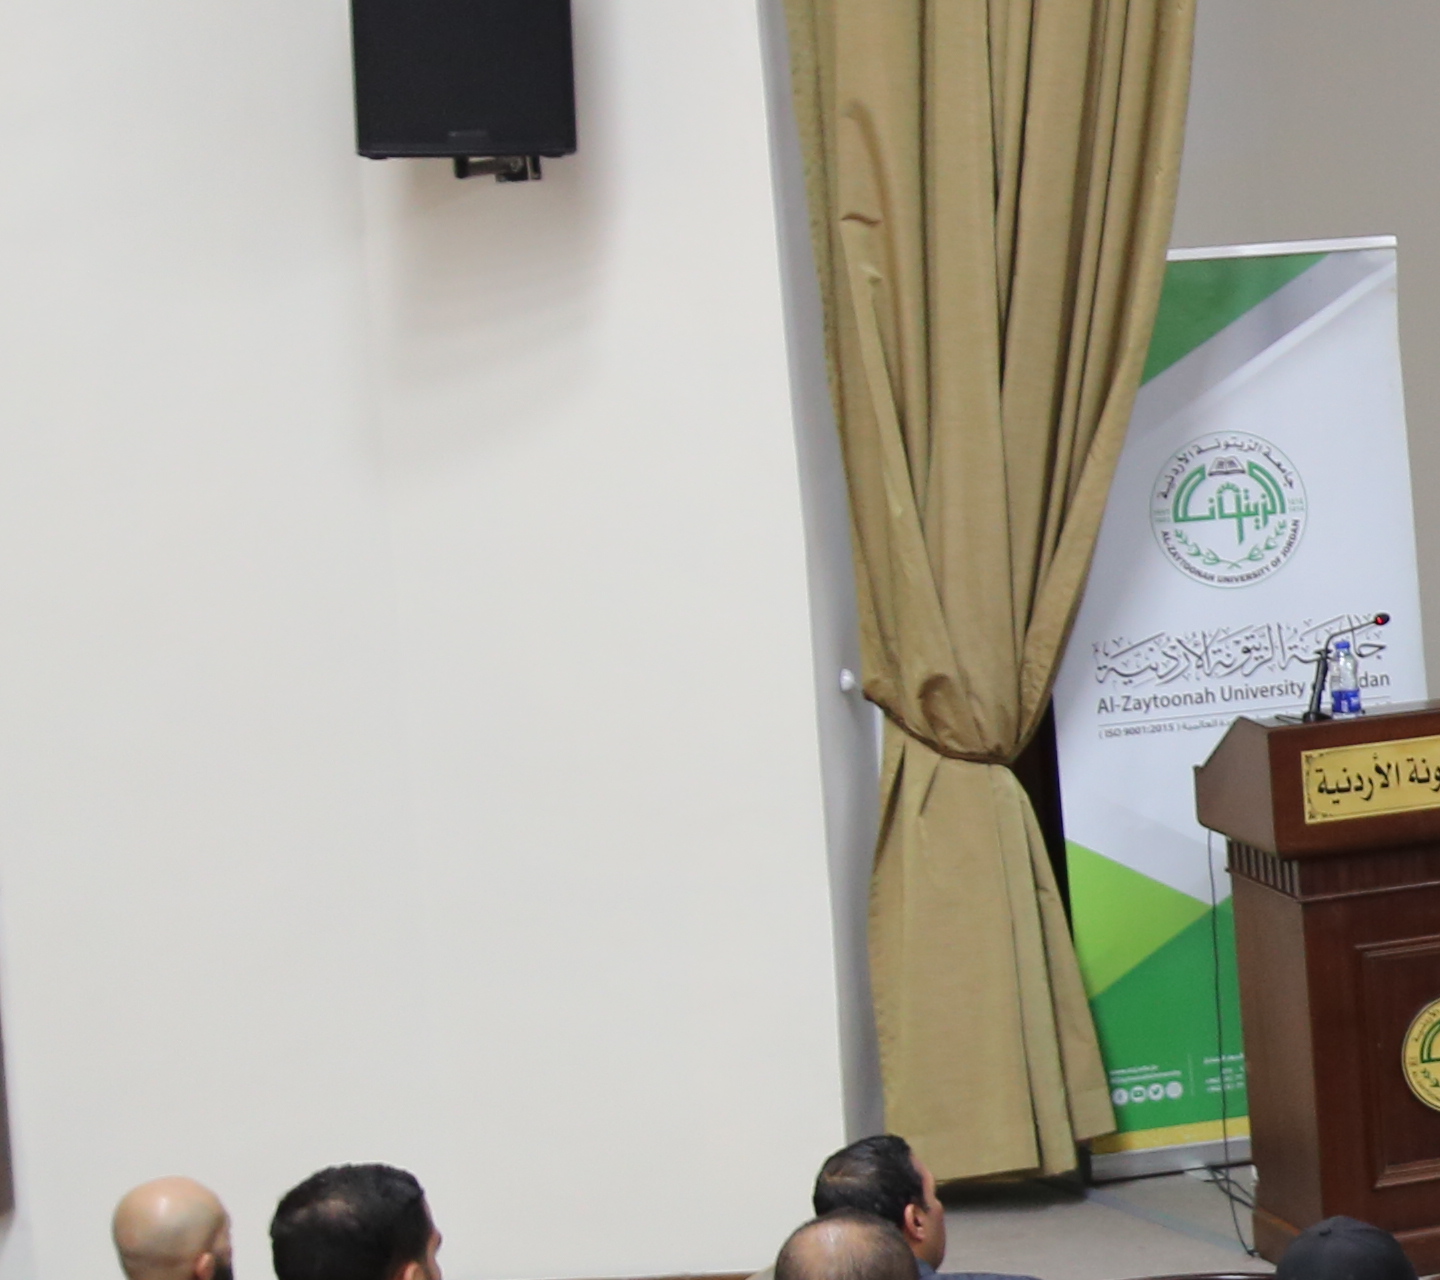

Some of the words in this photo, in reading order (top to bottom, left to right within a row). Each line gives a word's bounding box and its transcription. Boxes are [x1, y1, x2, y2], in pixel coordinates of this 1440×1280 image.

[1097, 685, 1217, 715] Al-Zaytoonah
[1220, 678, 1306, 702] University
[1315, 752, 1401, 805] الأردنية
